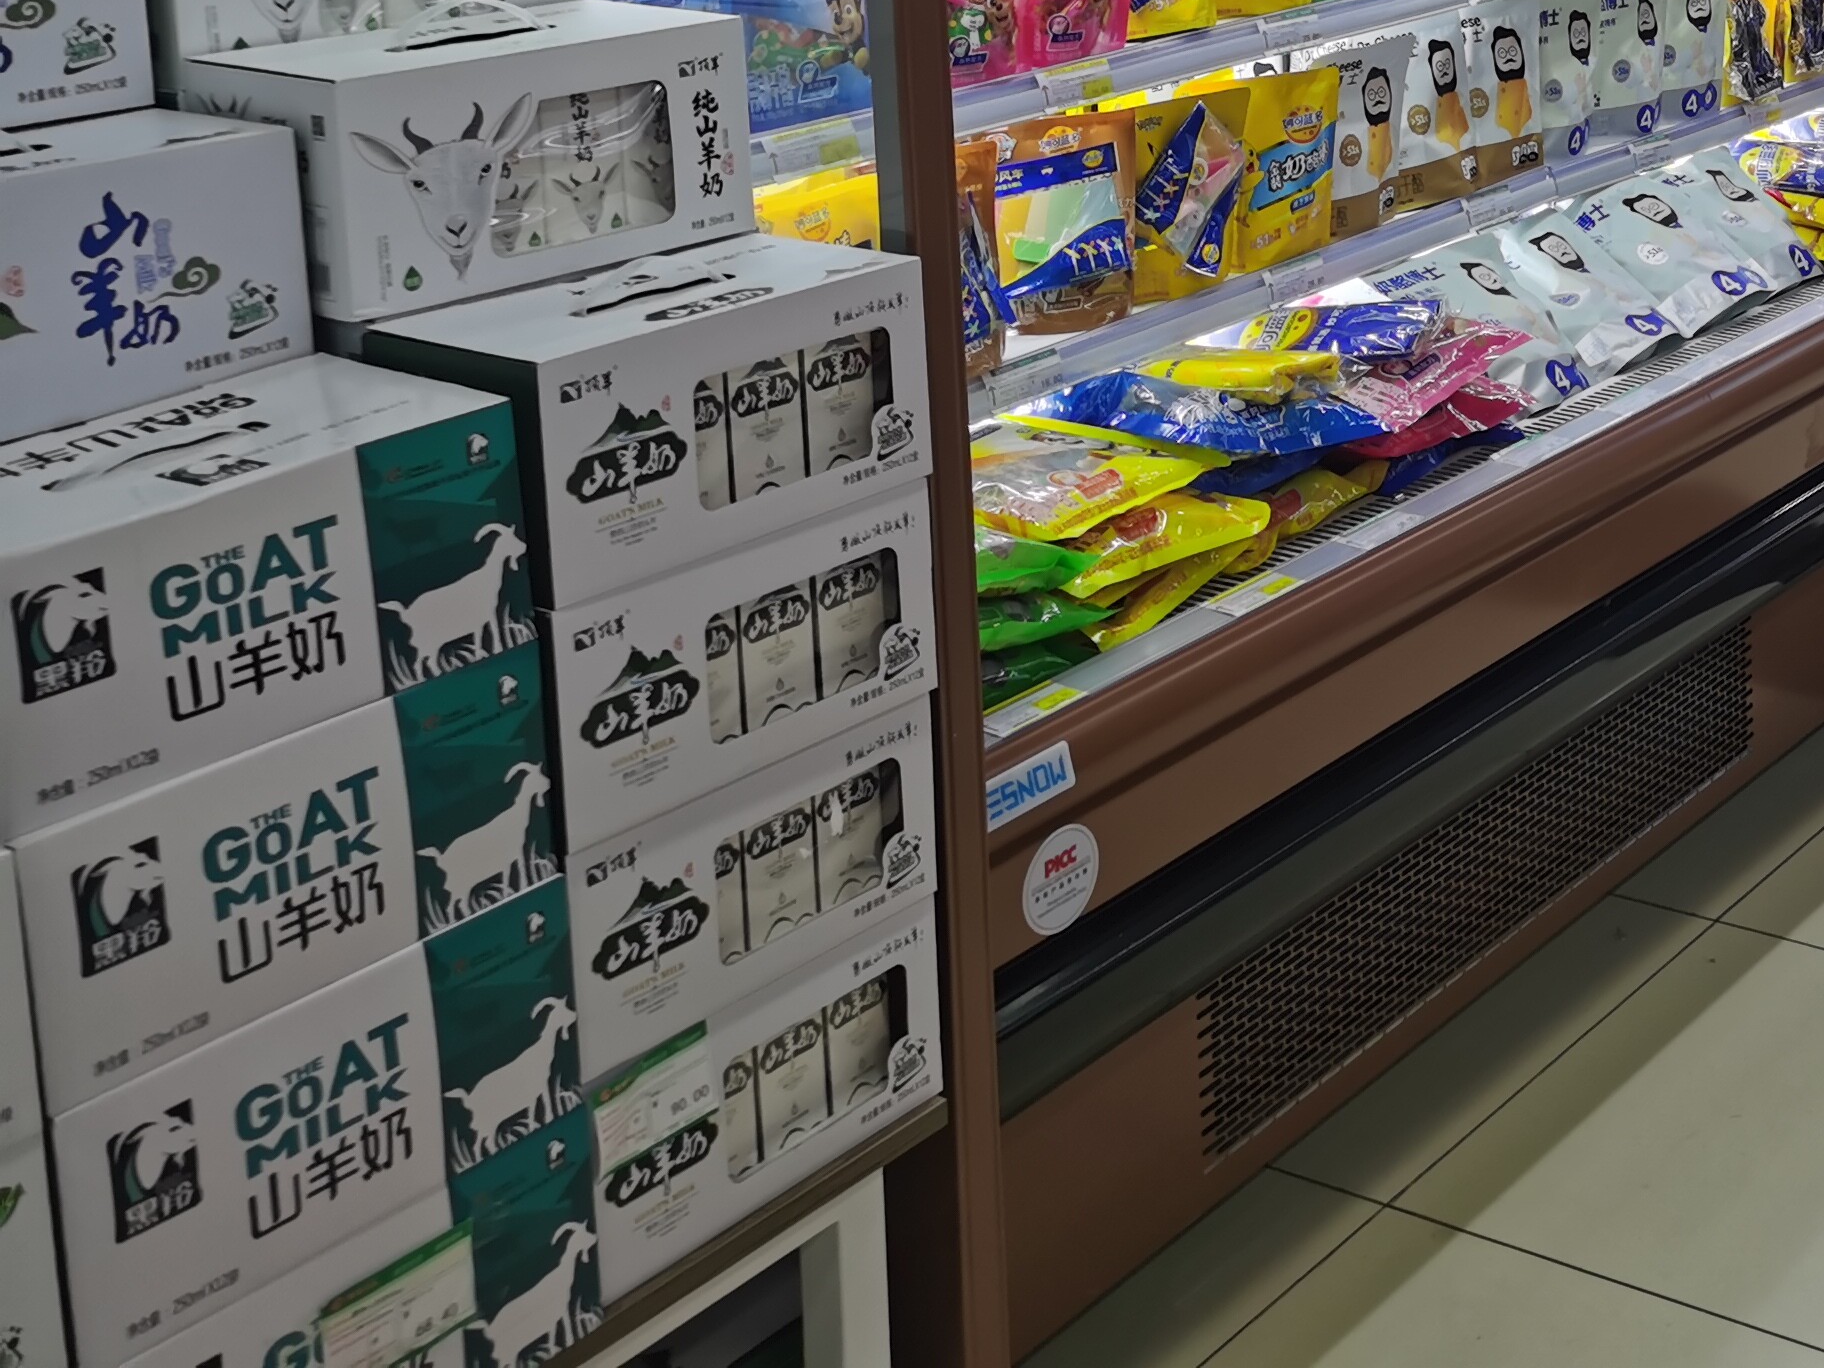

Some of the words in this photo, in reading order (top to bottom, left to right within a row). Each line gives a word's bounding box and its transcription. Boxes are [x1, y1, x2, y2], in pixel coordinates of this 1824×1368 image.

[1283, 109, 1324, 129] 妙可蓝多
[1640, 108, 1652, 130] 4
[1685, 93, 1698, 113] 4
[691, 88, 724, 199] 纯山羊奶
[1571, 133, 1581, 153] 4
[995, 168, 1024, 184] 风车
[71, 190, 182, 367] 山羊奶
[1721, 274, 1741, 293] 4
[1794, 247, 1810, 271] 4
[1635, 315, 1656, 332] 4
[1554, 365, 1572, 391] 4
[582, 441, 677, 504] 山羊奶
[150, 514, 338, 620] GOAT
[199, 545, 246, 568] THE
[161, 571, 341, 659] MILK
[166, 610, 347, 722] 山羊奶
[595, 682, 689, 744] 山羊奶
[202, 766, 379, 884] GOAT
[249, 803, 293, 830] THE
[213, 822, 386, 922] MILK
[1044, 844, 1077, 879] PICC
[218, 862, 386, 984] 山羊奶
[607, 909, 699, 974] 山羊奶
[235, 1012, 409, 1143] GOAT
[281, 1055, 325, 1087] THE
[246, 1068, 410, 1181] MILK
[248, 1107, 413, 1240] 山羊奶
[619, 1132, 709, 1195] 山羊奶
